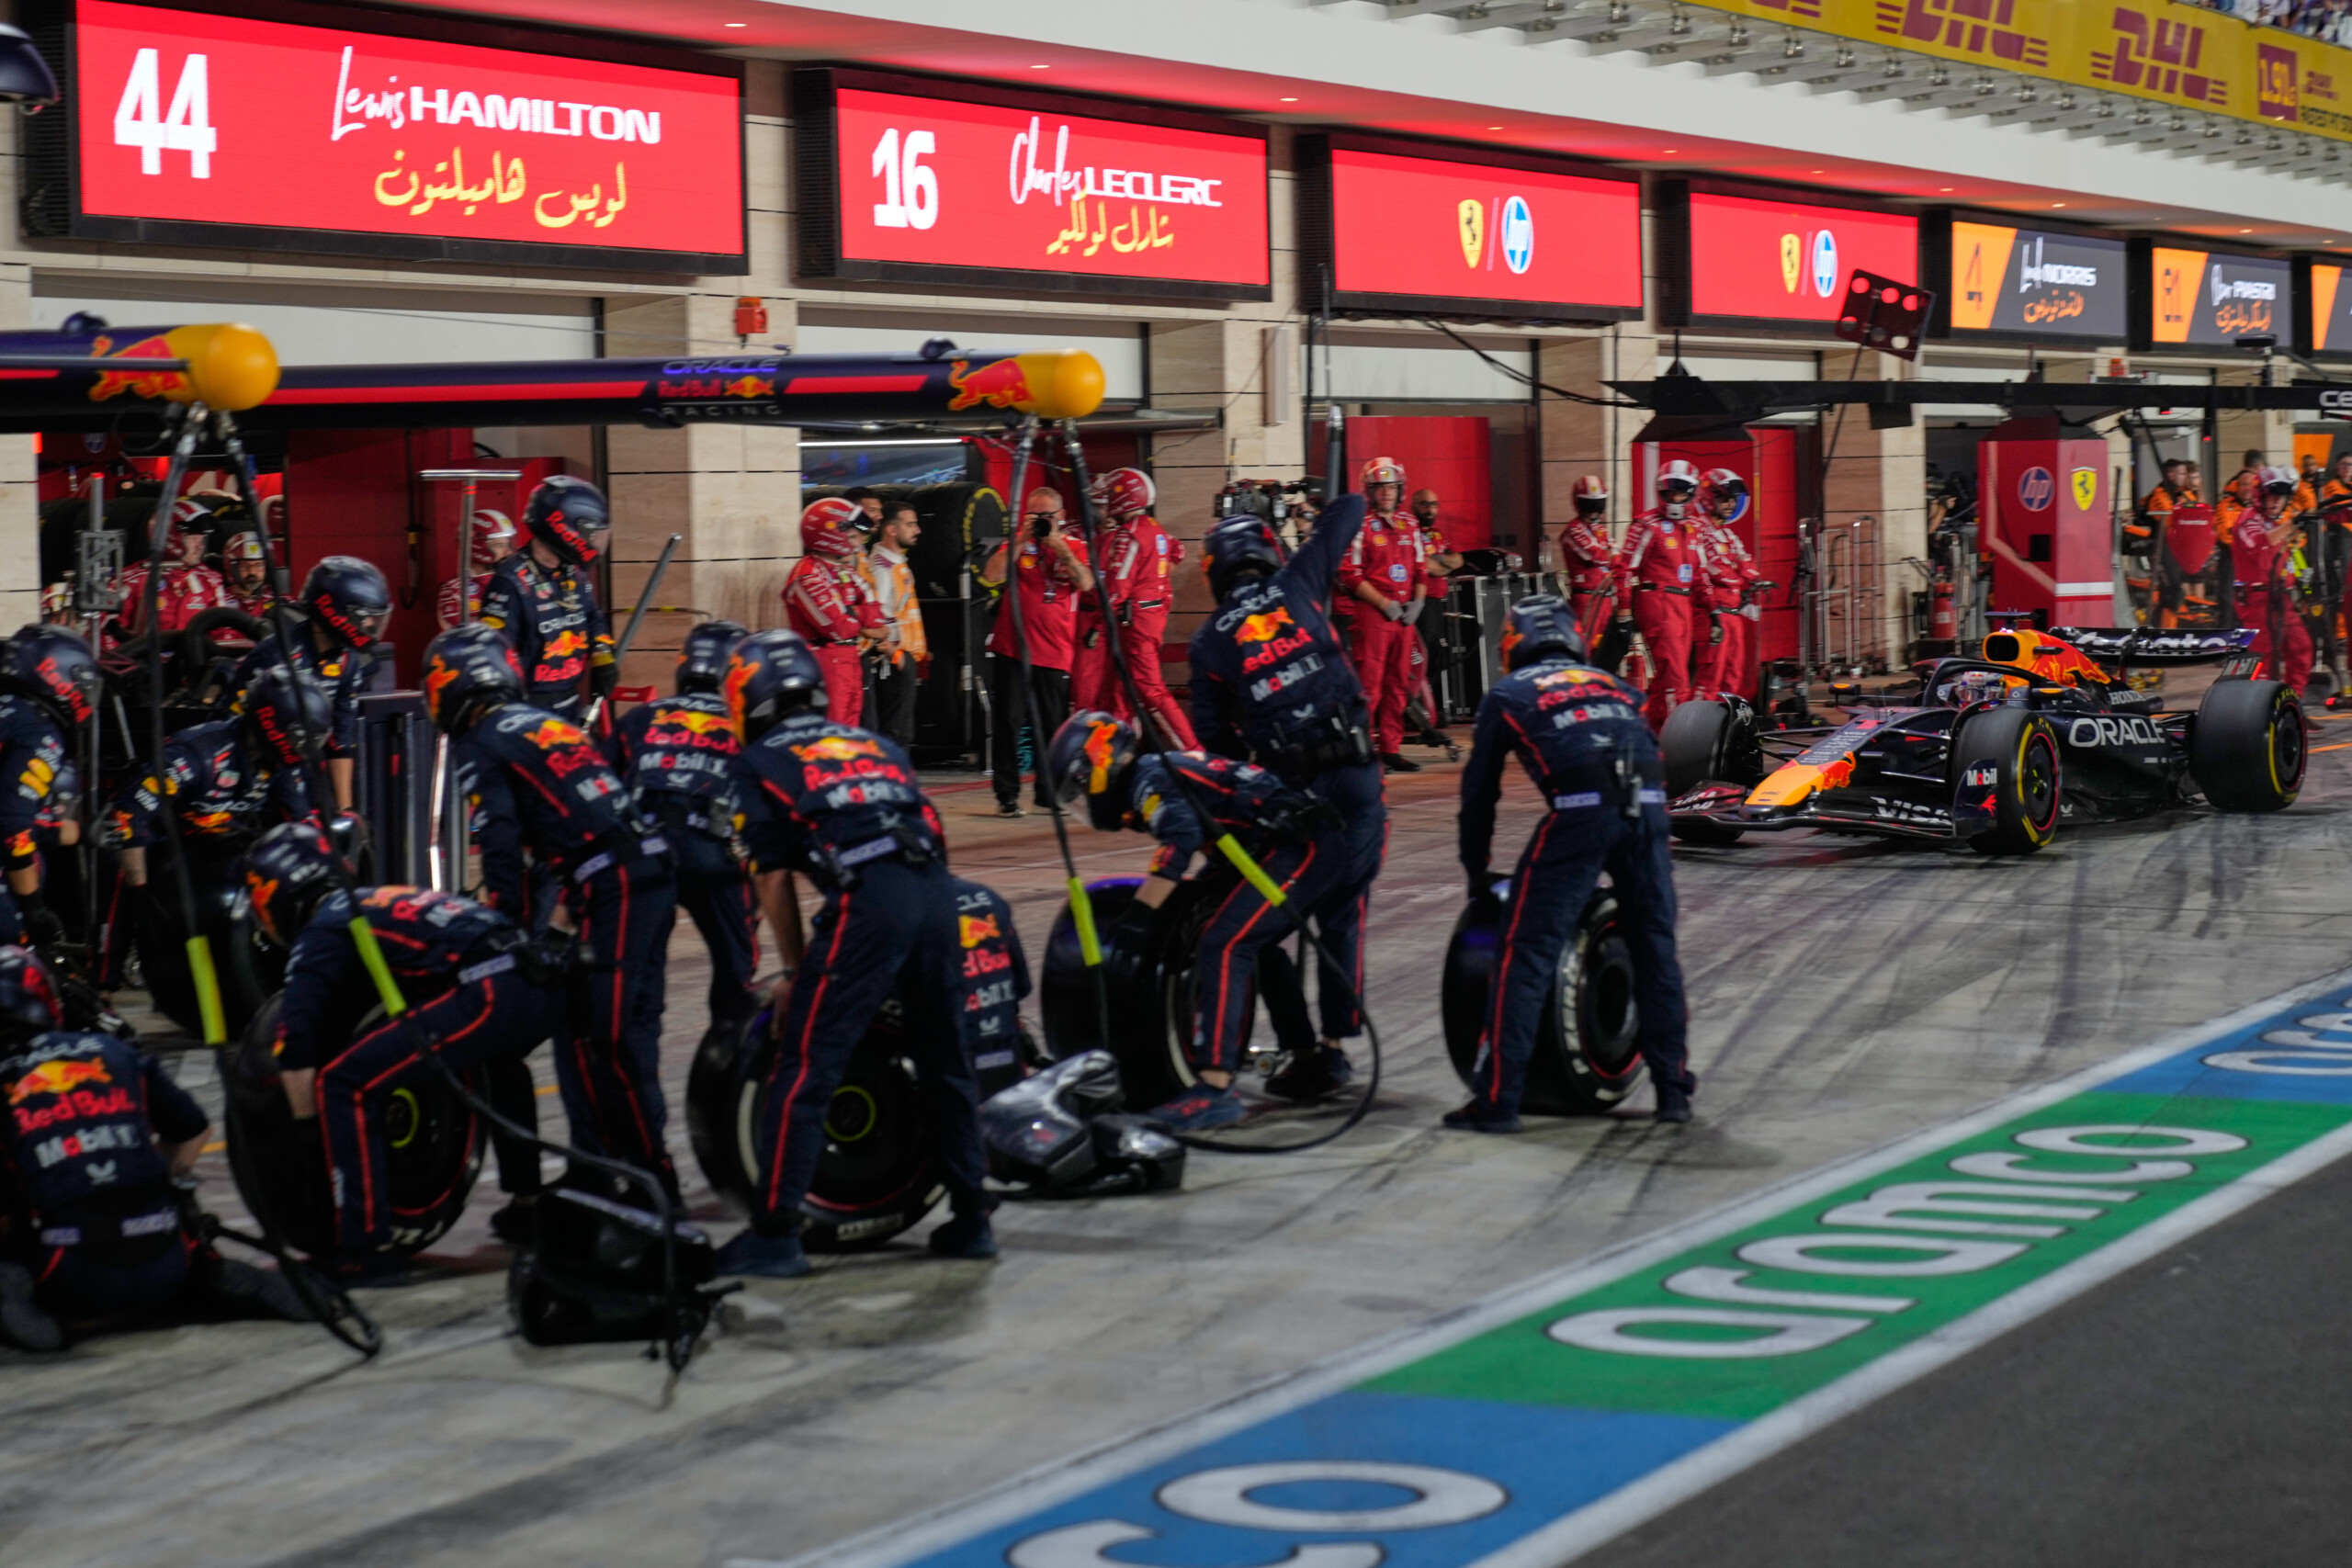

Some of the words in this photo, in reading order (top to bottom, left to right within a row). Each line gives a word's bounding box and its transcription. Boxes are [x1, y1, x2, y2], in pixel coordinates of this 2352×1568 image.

[2112, 6, 2211, 101] DHL
[113, 48, 217, 179] 44
[331, 46, 405, 141] Lewis
[410, 85, 662, 144] HAMILTON
[873, 129, 939, 230] 16
[1010, 116, 1083, 207] Charles
[1083, 166, 1222, 207] LECLERC
[1964, 242, 1983, 312] 4
[662, 358, 779, 374] ORACLE
[658, 379, 688, 397] Red
[661, 405, 780, 416] RACING
[1215, 585, 1285, 632] ORACLE
[1250, 660, 1306, 701] Mobil
[1552, 704, 1614, 729] Mobil
[2068, 717, 2166, 748] ORACLE
[639, 751, 707, 771] Mobil
[1967, 768, 1997, 786] Mobil
[825, 781, 893, 809] Mobil
[35, 1124, 116, 1168] Mobil
[1544, 1123, 2254, 1359] aramco
